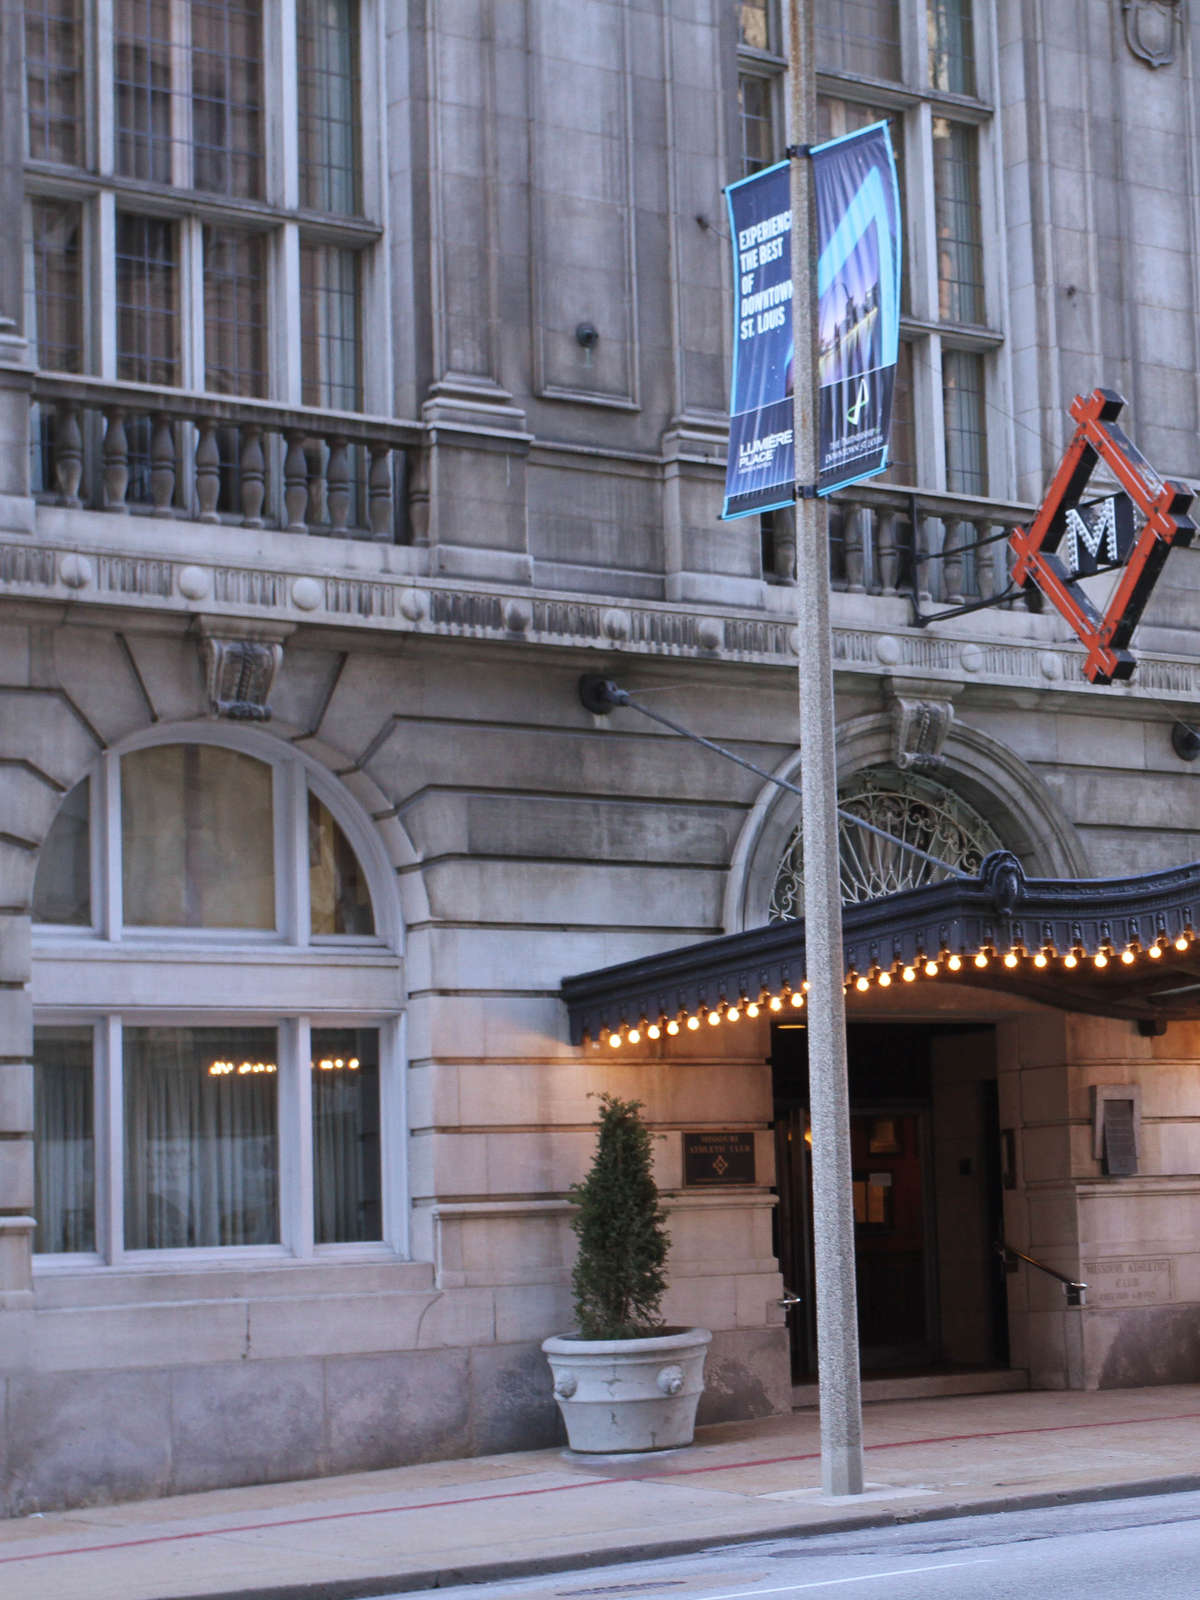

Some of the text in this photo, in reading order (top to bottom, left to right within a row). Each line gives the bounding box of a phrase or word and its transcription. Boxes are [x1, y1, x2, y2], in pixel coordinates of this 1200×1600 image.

[739, 210, 792, 251] EXPERIENC
[740, 236, 784, 273] THE BEST
[741, 272, 755, 295] OF
[741, 279, 794, 318] DOWNTOWN
[740, 305, 786, 340] ST. LOUIS
[739, 449, 776, 469] PLACE
[1066, 498, 1117, 571] M
